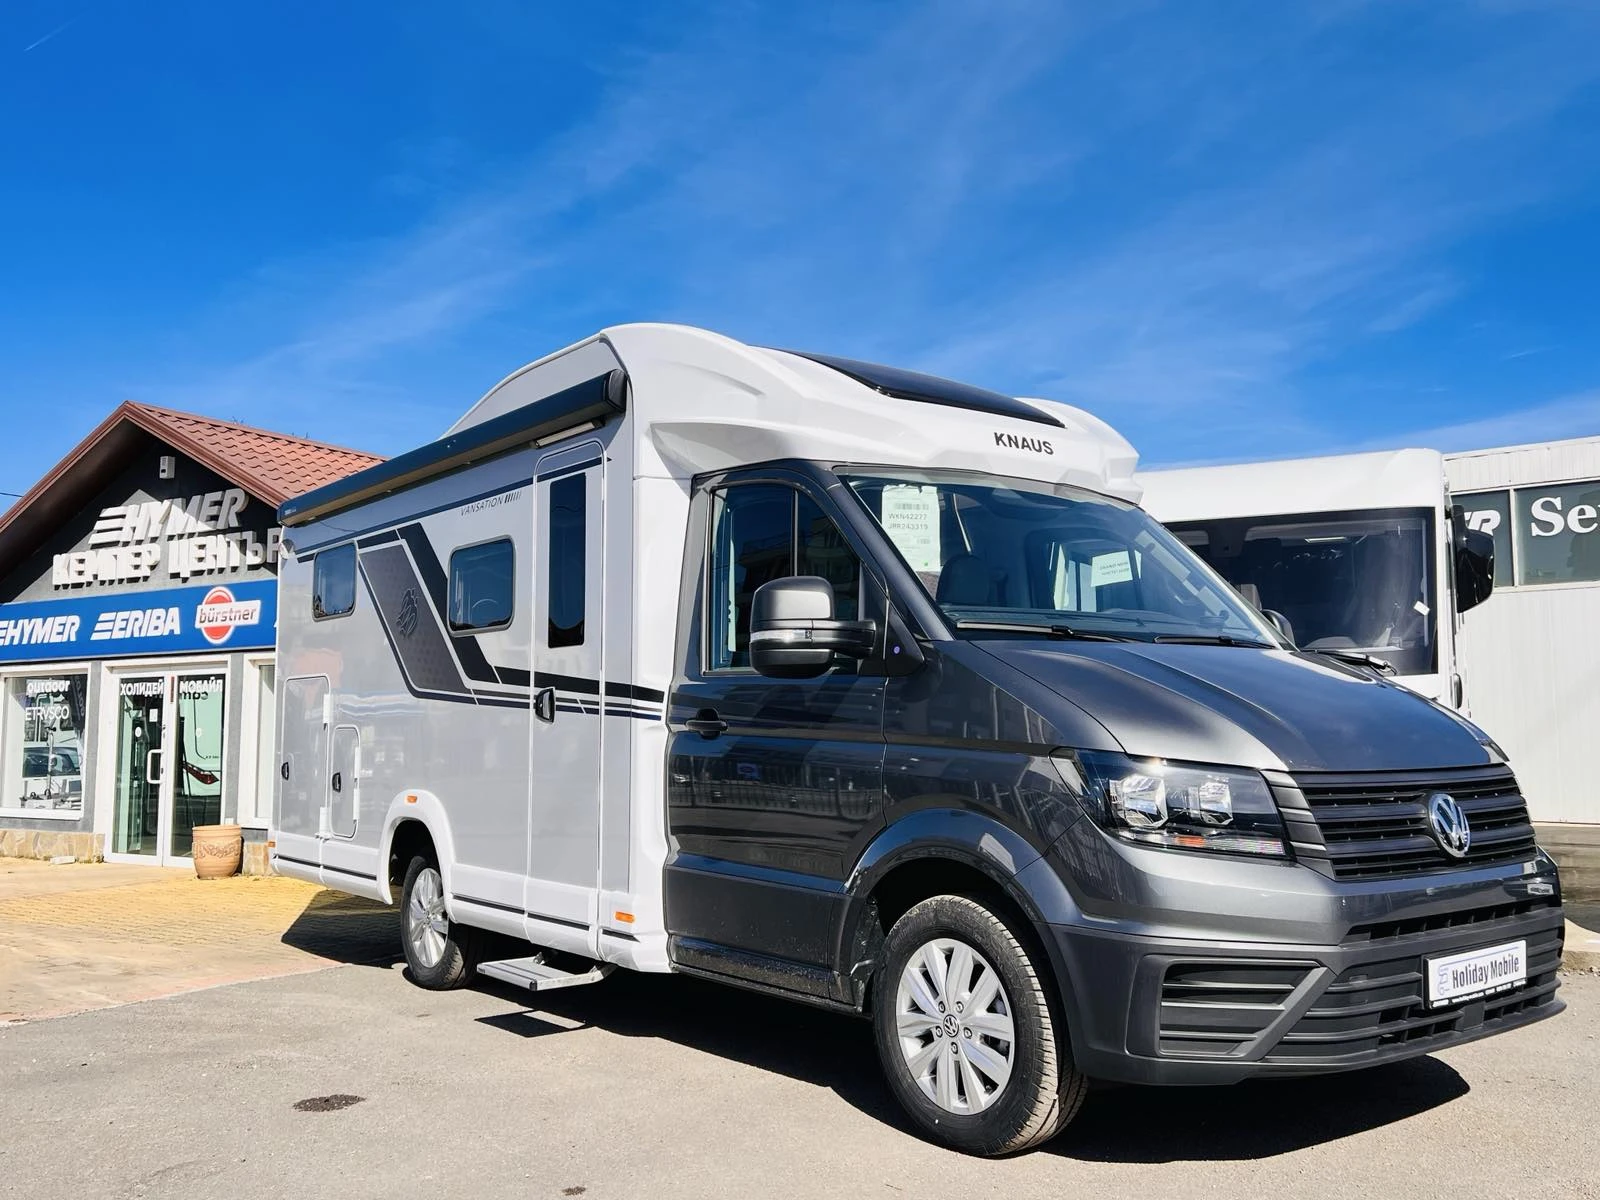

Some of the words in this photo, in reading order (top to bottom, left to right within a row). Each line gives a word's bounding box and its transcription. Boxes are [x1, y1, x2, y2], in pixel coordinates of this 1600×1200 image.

[993, 432, 1054, 455] KNAUS
[460, 495, 504, 517] VANSATION
[1531, 496, 1600, 537] Se
[3, 615, 81, 645] HYMER
[108, 607, 181, 640] ERIBA
[199, 606, 257, 624] bürstner
[120, 679, 164, 697] ХОЛИДЕЙ
[1452, 963, 1489, 989] Holiday
[1490, 954, 1520, 980] Mobile
